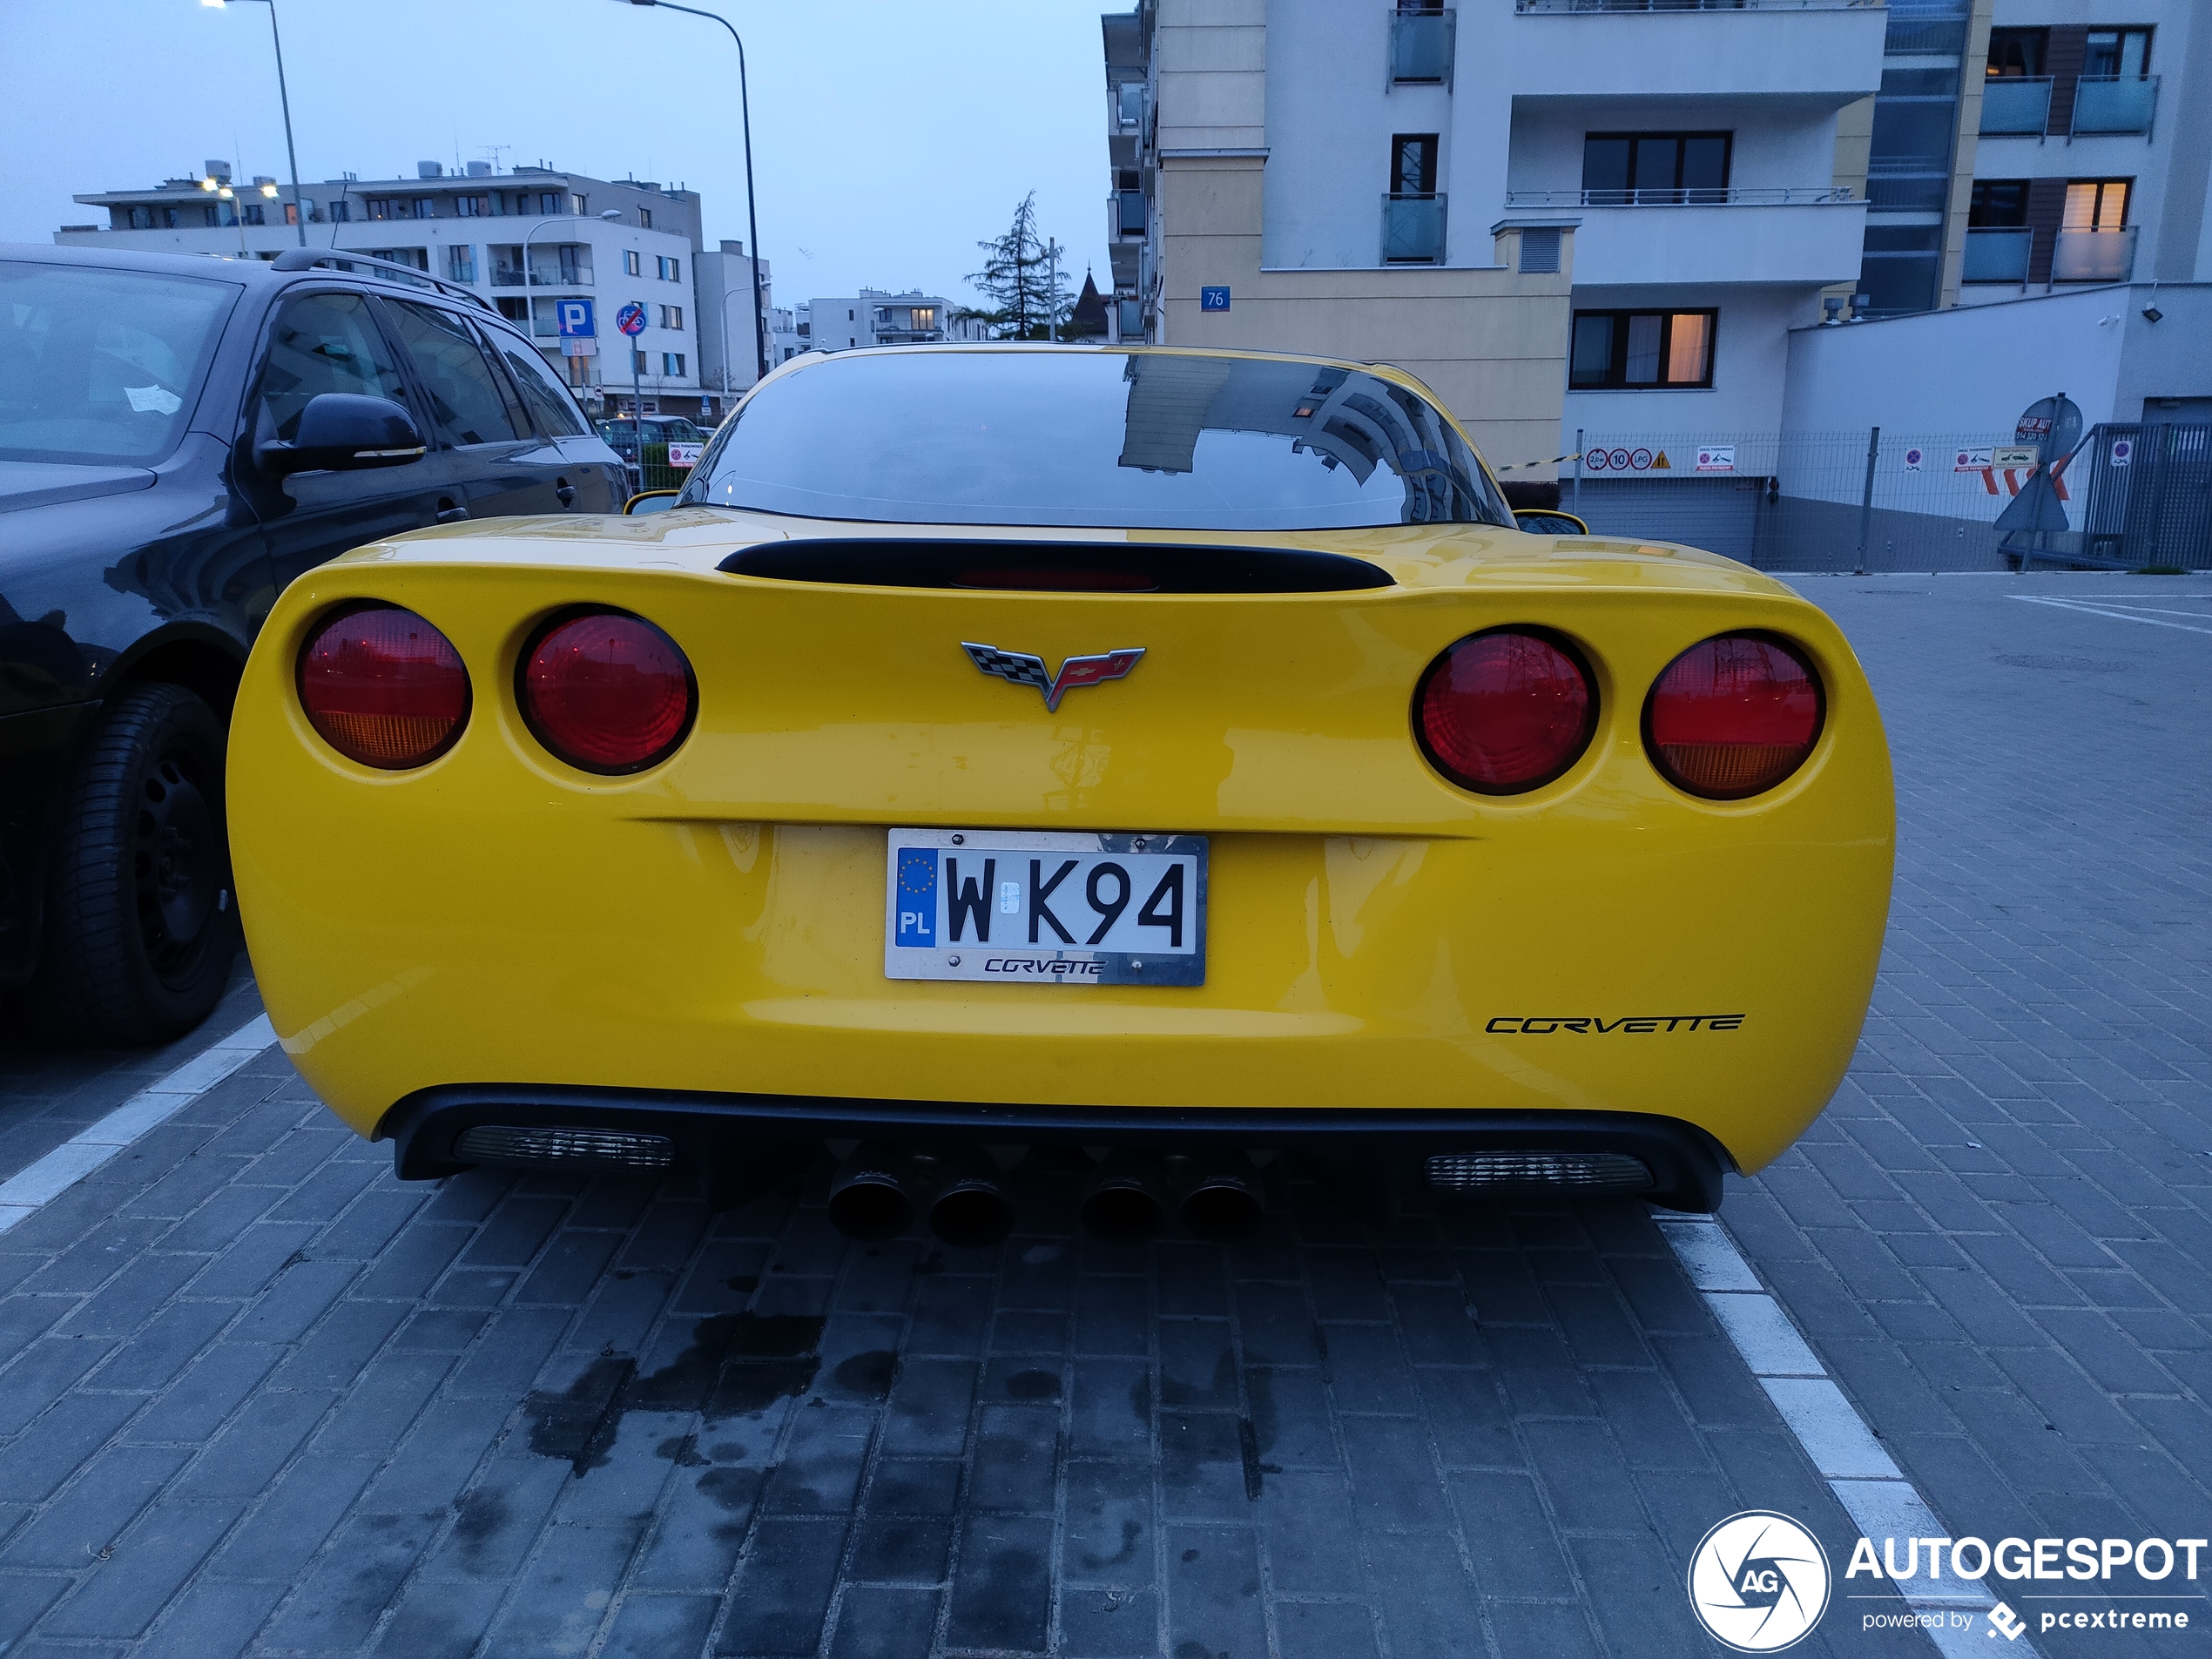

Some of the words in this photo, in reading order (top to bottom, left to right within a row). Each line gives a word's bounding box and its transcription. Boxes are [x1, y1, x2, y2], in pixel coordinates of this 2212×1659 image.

[1208, 292, 1224, 306] 76
[563, 304, 586, 334] P
[2019, 417, 2038, 428] SKUP
[2037, 418, 2052, 429] AUT
[1614, 455, 1625, 465] 10
[900, 912, 930, 934] PL
[984, 959, 1107, 974] CORVETTE
[1485, 1014, 1746, 1034] CORVETTE
